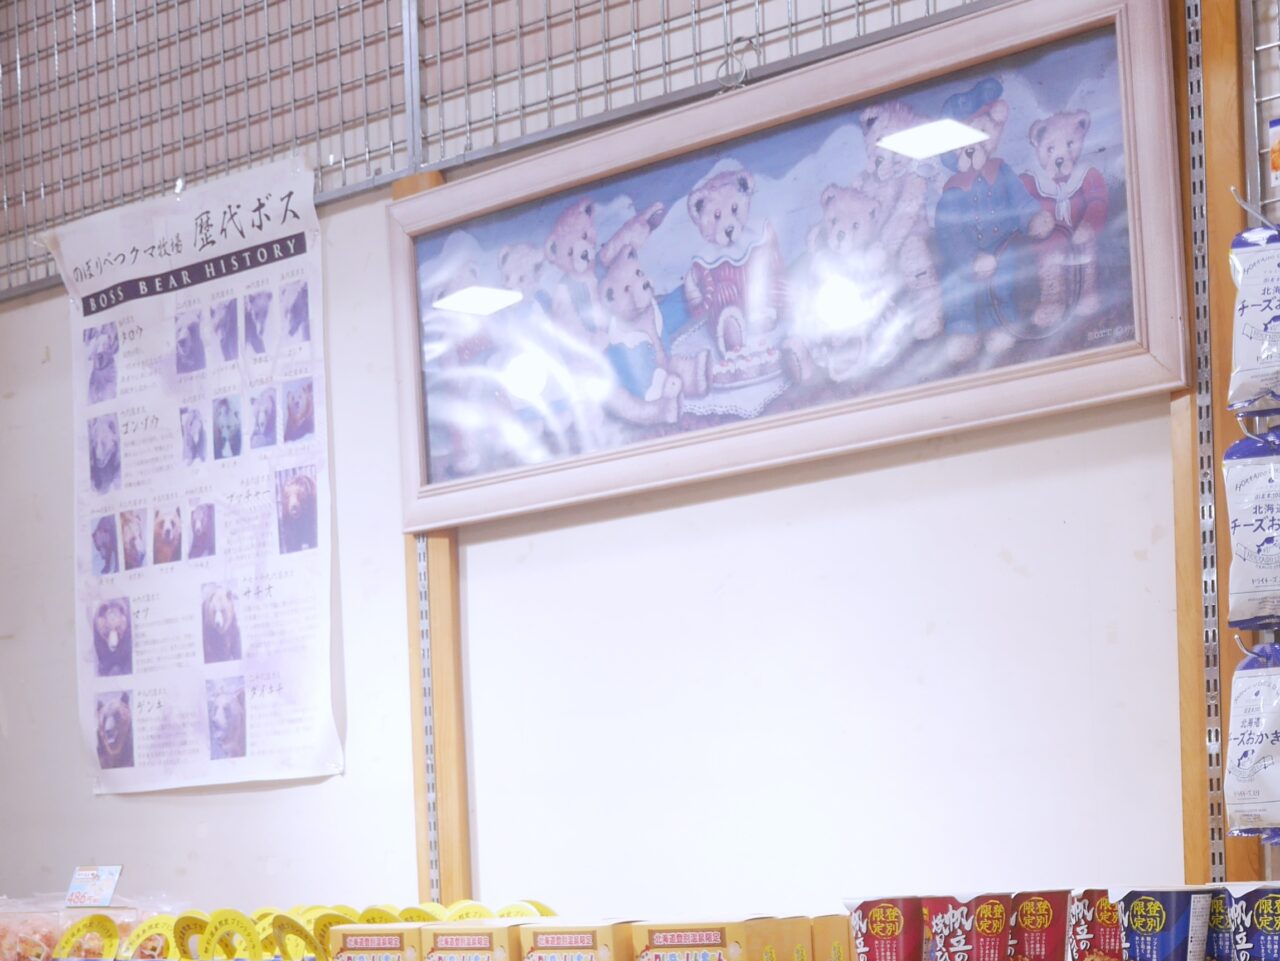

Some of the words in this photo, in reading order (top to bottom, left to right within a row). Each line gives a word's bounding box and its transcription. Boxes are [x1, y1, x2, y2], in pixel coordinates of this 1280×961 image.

[193, 191, 300, 252] 歴代ボス
[89, 287, 124, 311] BOSS
[139, 270, 191, 295] BEAR
[205, 239, 297, 278] HISTORY
[654, 929, 721, 945] 北海道登別温泉限定
